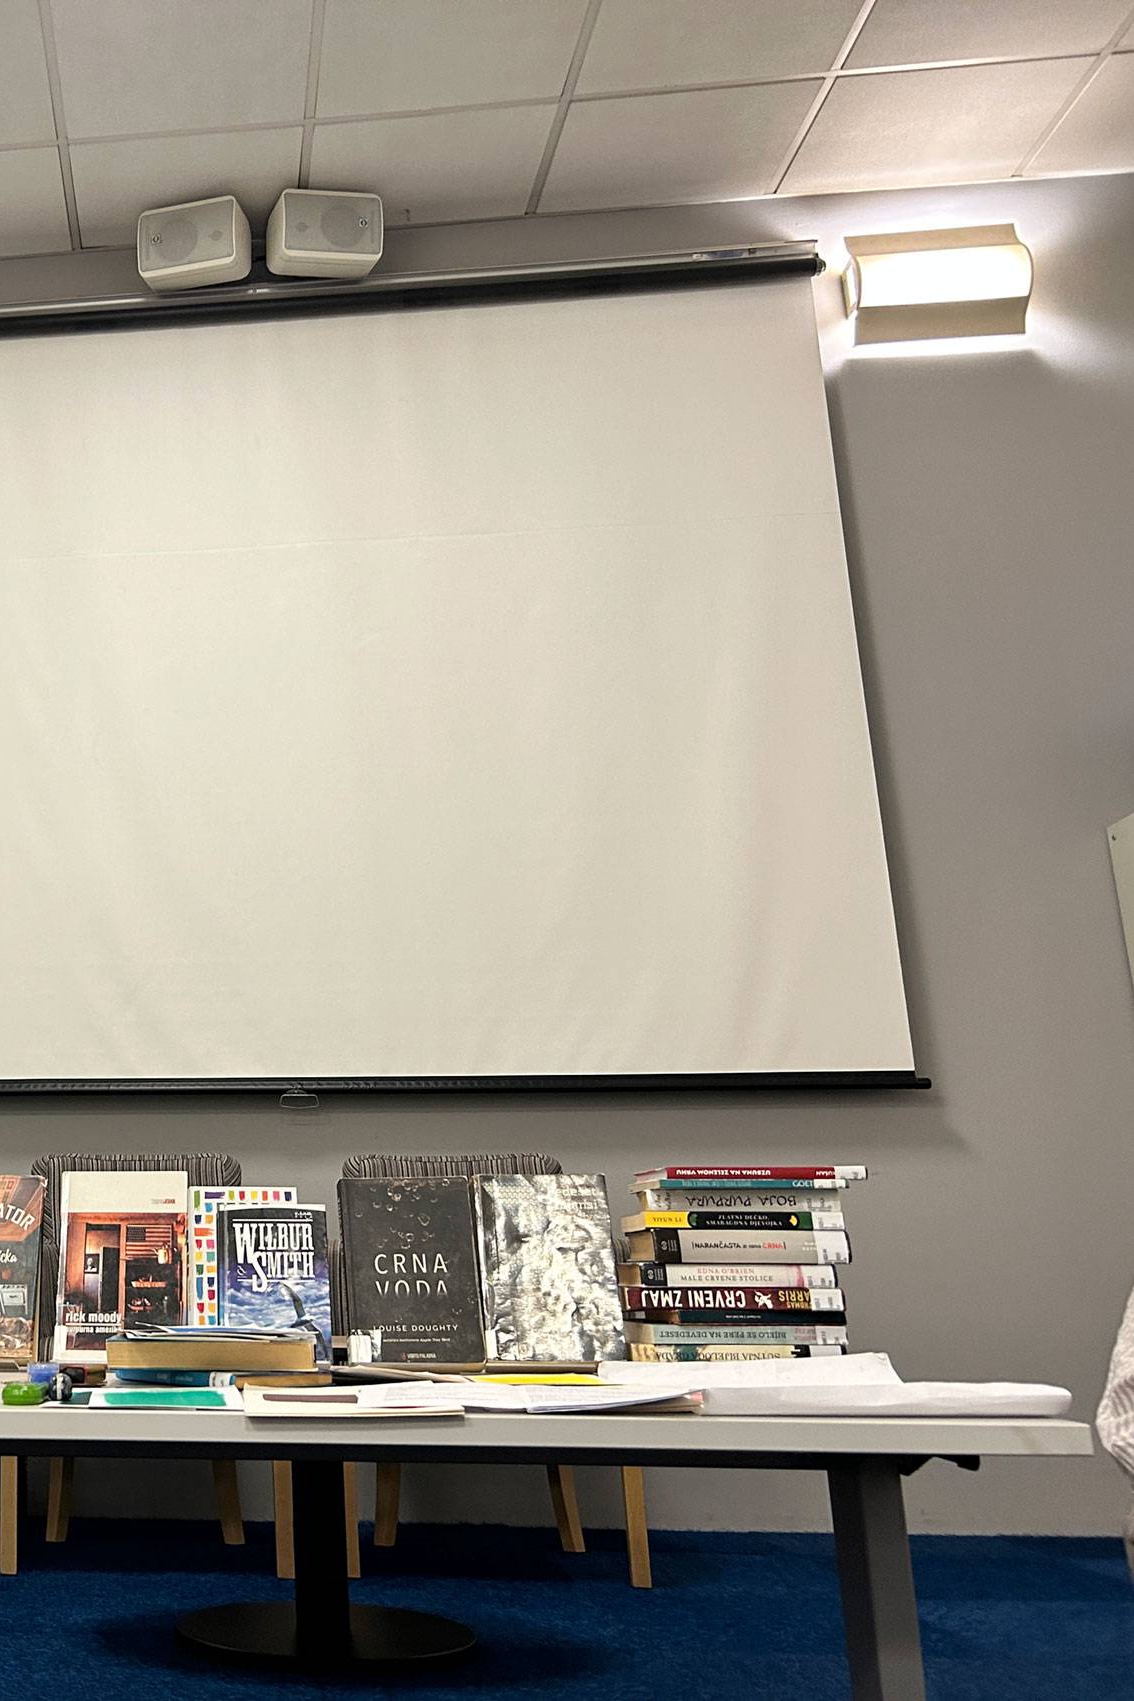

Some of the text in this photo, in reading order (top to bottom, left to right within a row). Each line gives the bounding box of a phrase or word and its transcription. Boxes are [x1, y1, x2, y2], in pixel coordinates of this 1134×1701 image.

[686, 1195, 752, 1207] PURPURA
[758, 1195, 797, 1206] BOJA
[232, 1223, 315, 1264] WILBUR
[374, 1253, 448, 1275] CRNA
[252, 1251, 315, 1292] SMITH
[375, 1279, 448, 1298] VODA
[641, 1290, 746, 1308] CRVENI ZMAJ
[778, 1290, 810, 1302] ARRIS
[66, 1310, 122, 1325] rick moody
[373, 1324, 407, 1332] LOUISE
[659, 1330, 707, 1338] DEVEDESET
[724, 1331, 745, 1339] PERE
[747, 1331, 756, 1339] SE
[758, 1331, 787, 1339] BIJELO
